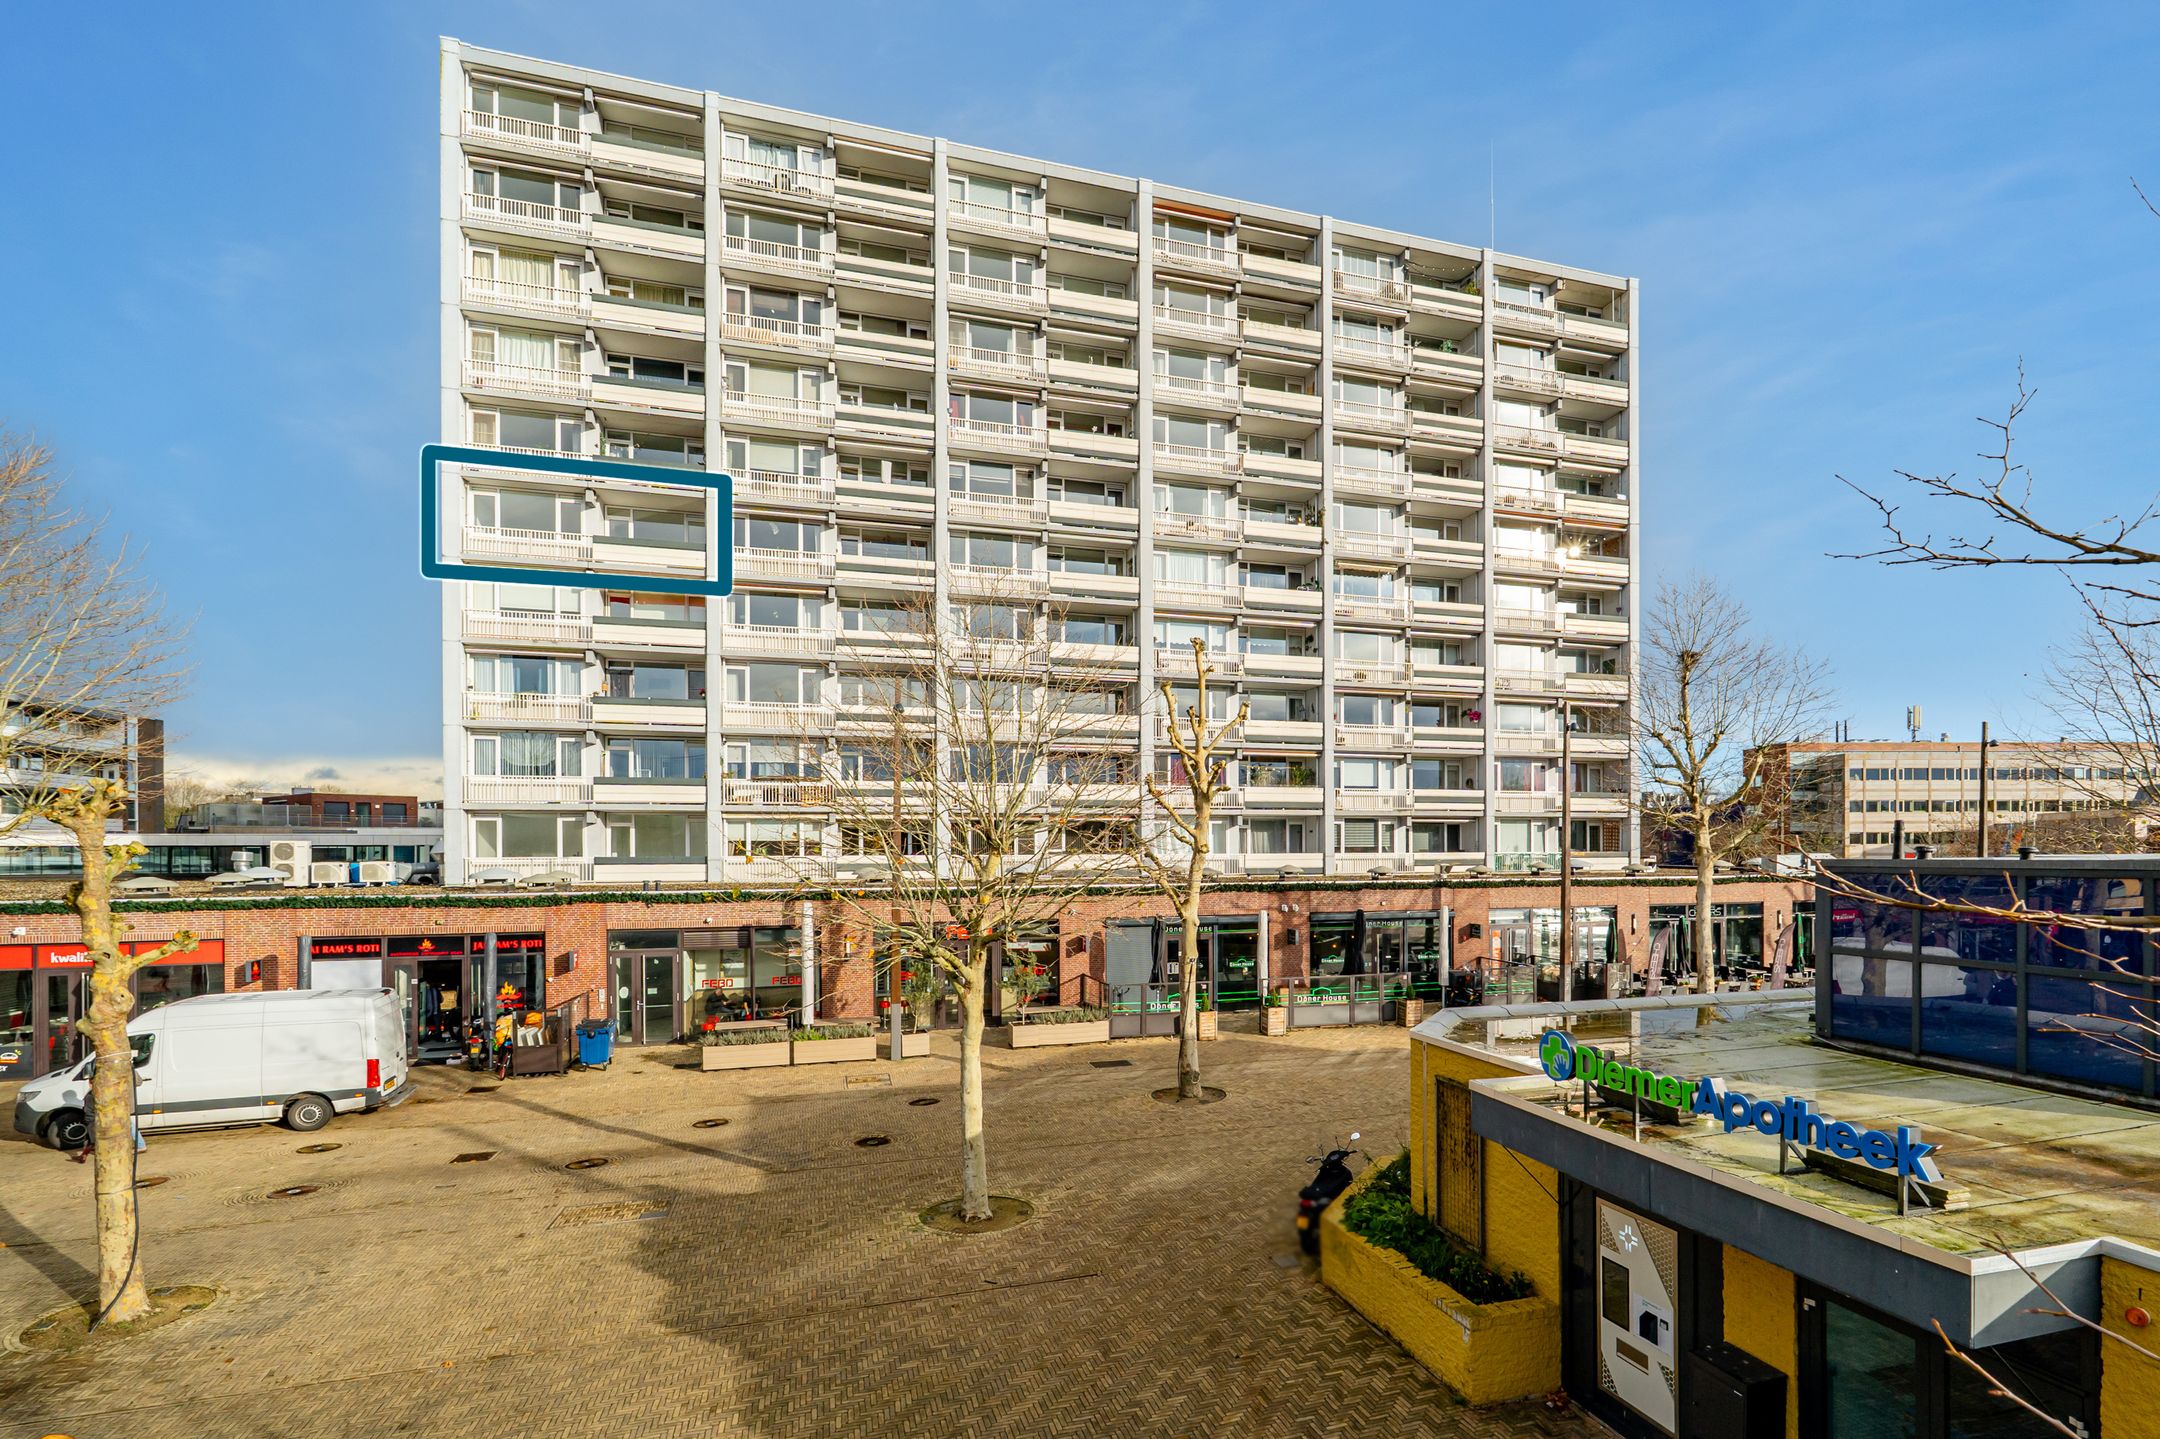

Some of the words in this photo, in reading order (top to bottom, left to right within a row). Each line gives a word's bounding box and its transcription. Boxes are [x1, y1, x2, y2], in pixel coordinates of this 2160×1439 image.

[356, 943, 380, 953] ROTI
[520, 939, 543, 949] ROTI
[1649, 942, 1661, 979] CHEERS
[1773, 938, 1786, 974] CHEERS
[701, 978, 734, 989] FEBO
[1322, 994, 1347, 1002] House
